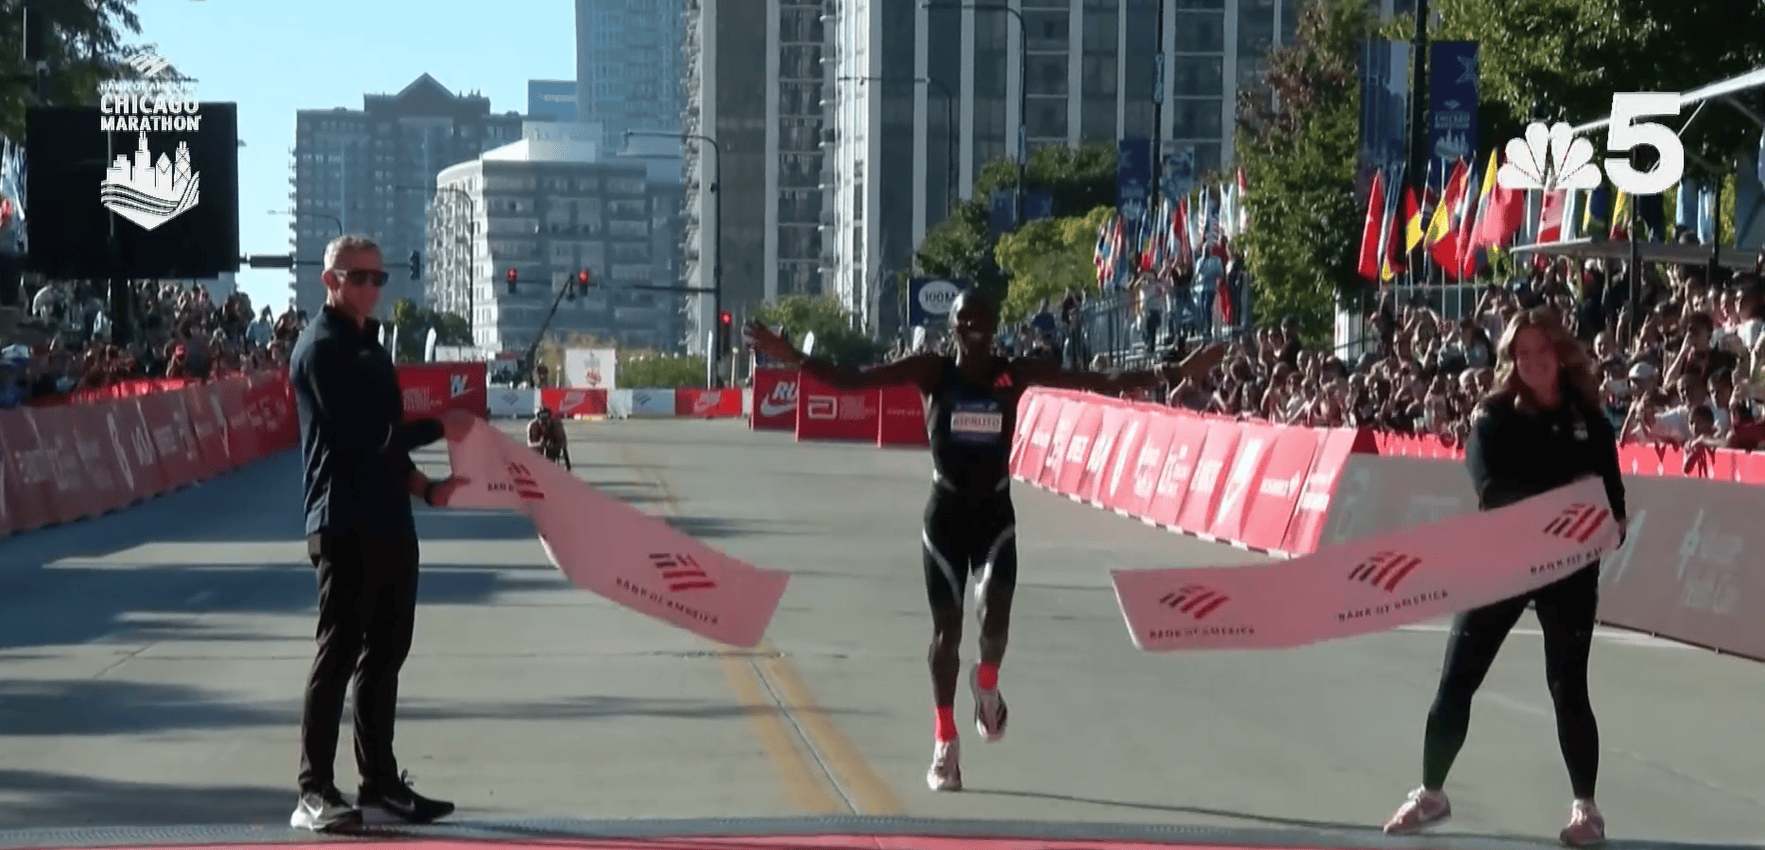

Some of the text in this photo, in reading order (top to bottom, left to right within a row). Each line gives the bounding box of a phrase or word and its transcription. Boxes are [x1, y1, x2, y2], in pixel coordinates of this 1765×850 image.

[616, 577, 647, 595] BANK
[1338, 607, 1371, 621] BANK
[1149, 628, 1181, 640] BANK
